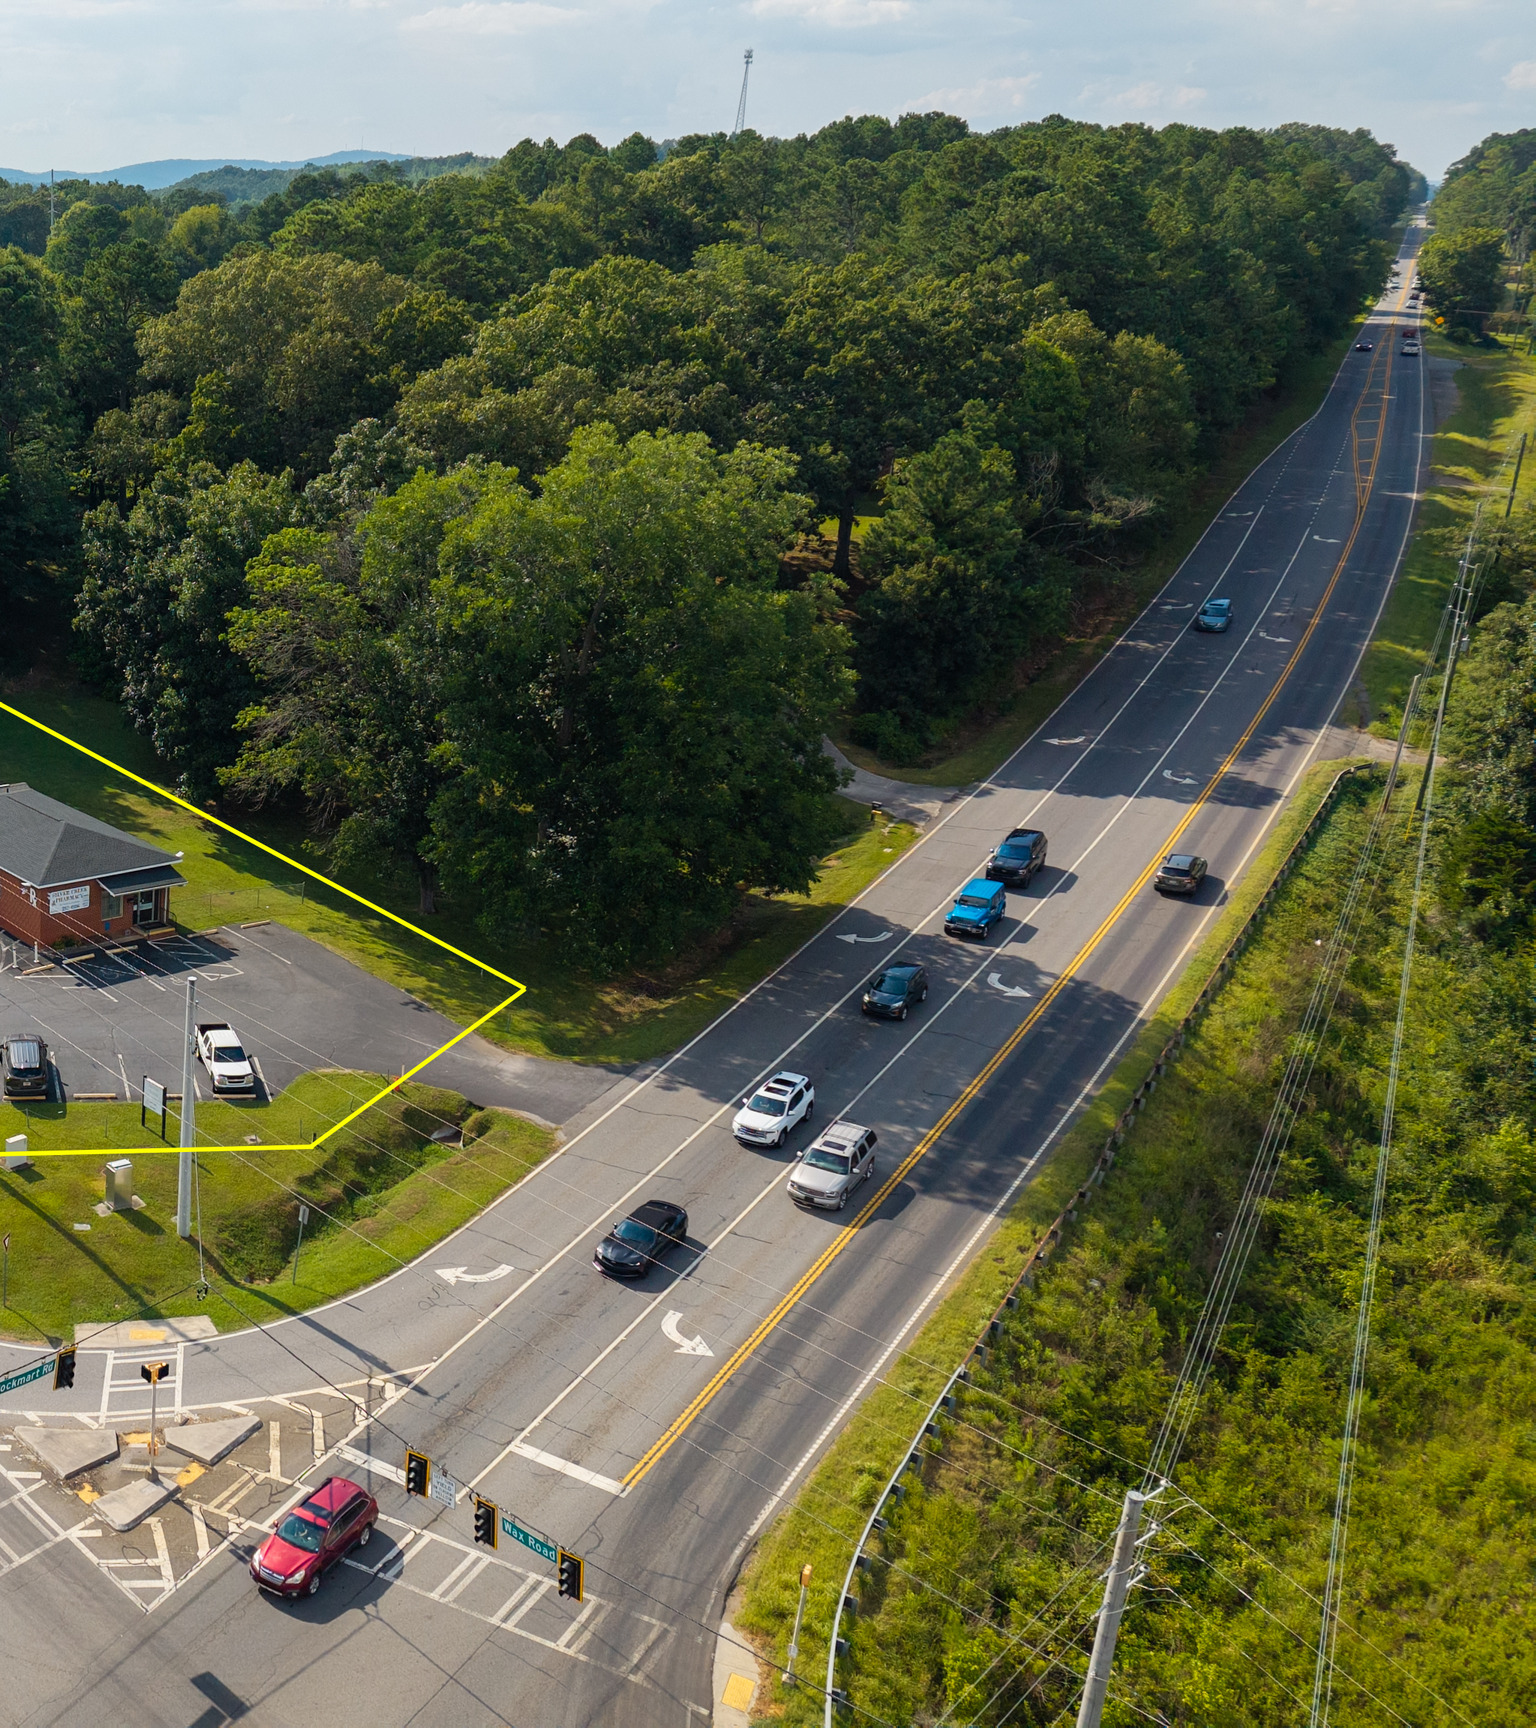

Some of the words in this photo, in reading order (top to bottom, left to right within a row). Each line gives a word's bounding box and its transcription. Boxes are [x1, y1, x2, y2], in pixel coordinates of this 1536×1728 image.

[42, 1361, 54, 1375] Rd
[504, 1519, 525, 1542] Wax
[528, 1536, 556, 1561] Road
